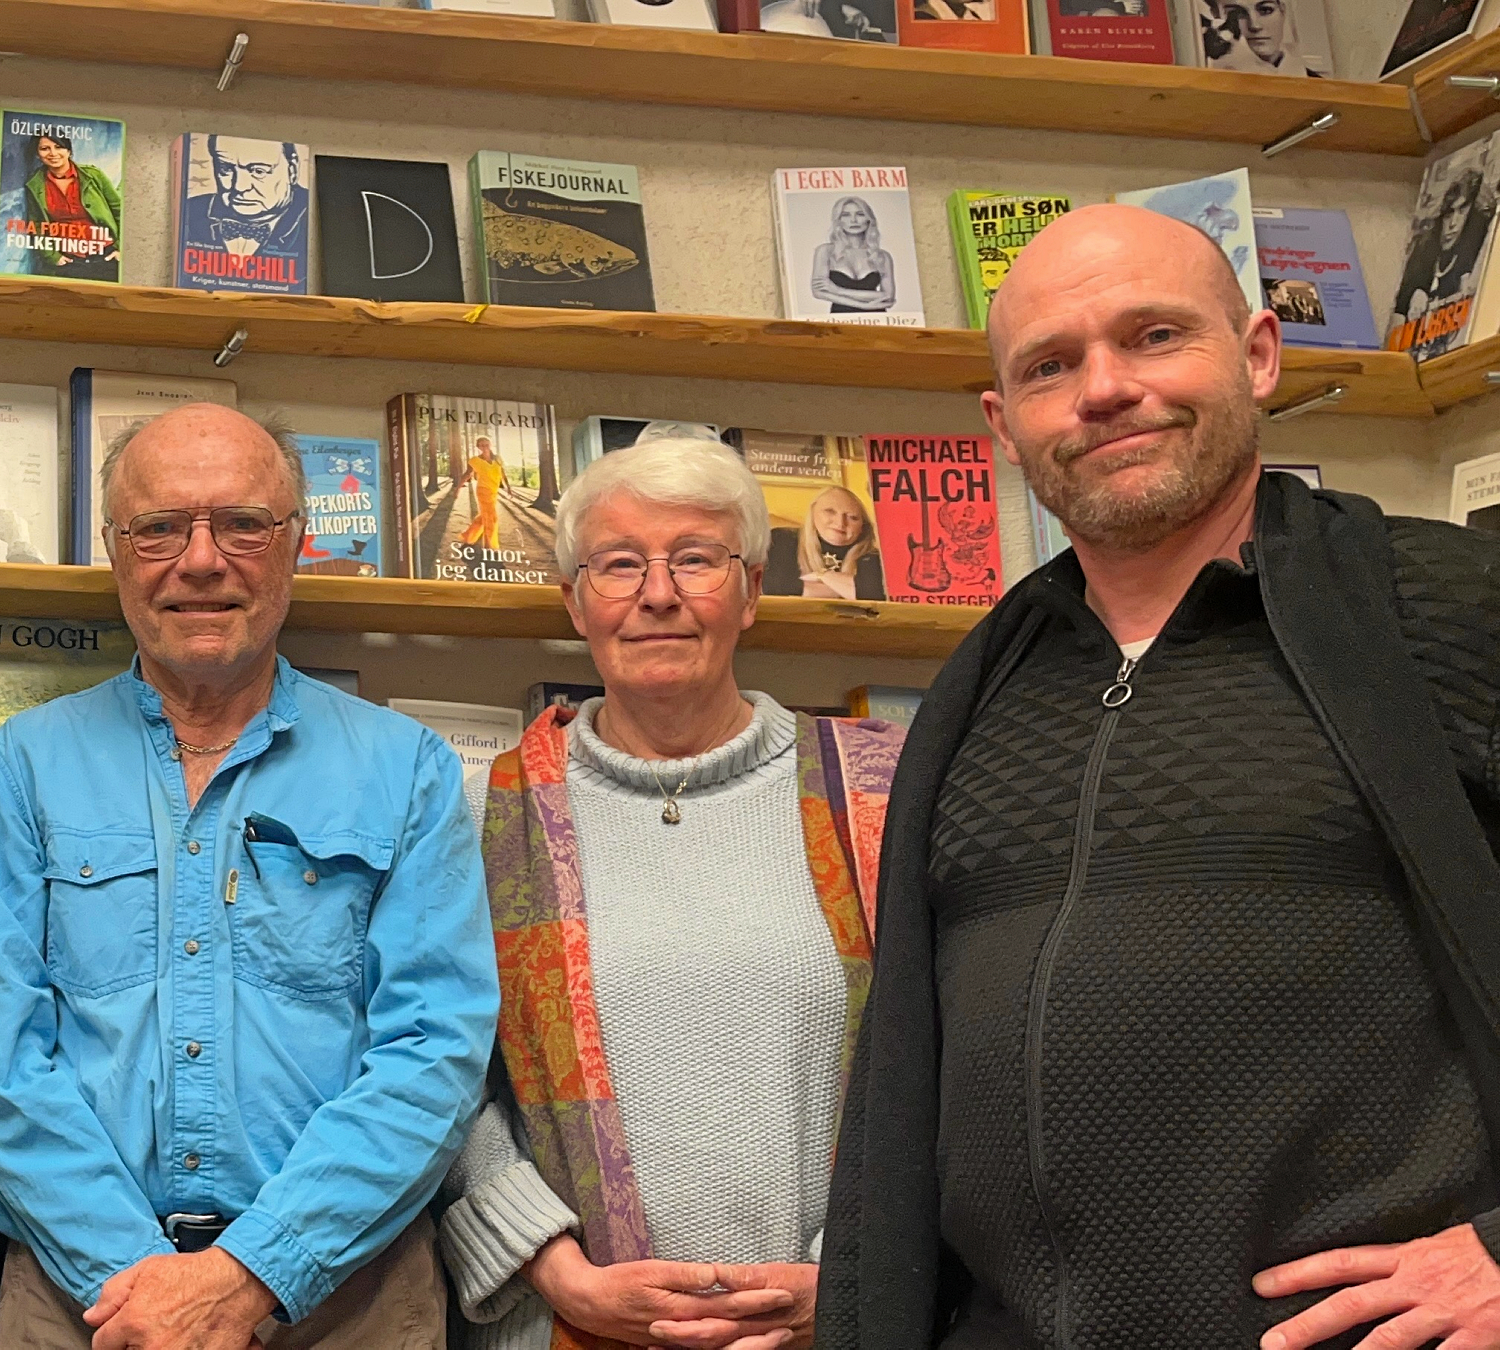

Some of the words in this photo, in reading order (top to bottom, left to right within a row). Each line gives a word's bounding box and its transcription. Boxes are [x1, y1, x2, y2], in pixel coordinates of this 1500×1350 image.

[11, 118, 53, 137] ÖZLEM
[56, 124, 93, 141] CEKIC
[783, 172, 790, 190] I
[797, 170, 845, 190] EGEN
[851, 169, 907, 189] BARM
[969, 203, 1016, 221] MIN
[1022, 198, 1071, 216] SØN
[6, 218, 37, 235] FRA
[41, 221, 87, 238] FØTEX
[89, 225, 113, 241] TIL
[362, 190, 433, 279] D
[972, 221, 997, 237] ER
[6, 233, 107, 256] FOLKETINGET
[183, 248, 299, 285] CHURCHILL
[192, 275, 216, 286] Kriger,
[218, 277, 251, 289] kunstner,
[252, 282, 290, 292] statsmand
[419, 406, 458, 422] PUK
[464, 410, 544, 429] ELGÅRD
[750, 448, 810, 463] Stemmer
[813, 453, 834, 467] fra
[837, 458, 853, 466] en
[869, 439, 988, 463] MICHAEL
[751, 462, 793, 474] anden
[798, 466, 842, 478] verden
[871, 468, 991, 503] FALCH
[450, 541, 475, 561] Se
[481, 547, 531, 567] mor,
[435, 558, 468, 582] jeg
[472, 562, 548, 585] danser
[12, 625, 100, 651] GOGH
[450, 733, 498, 749] Gifford
[503, 738, 507, 750] i
